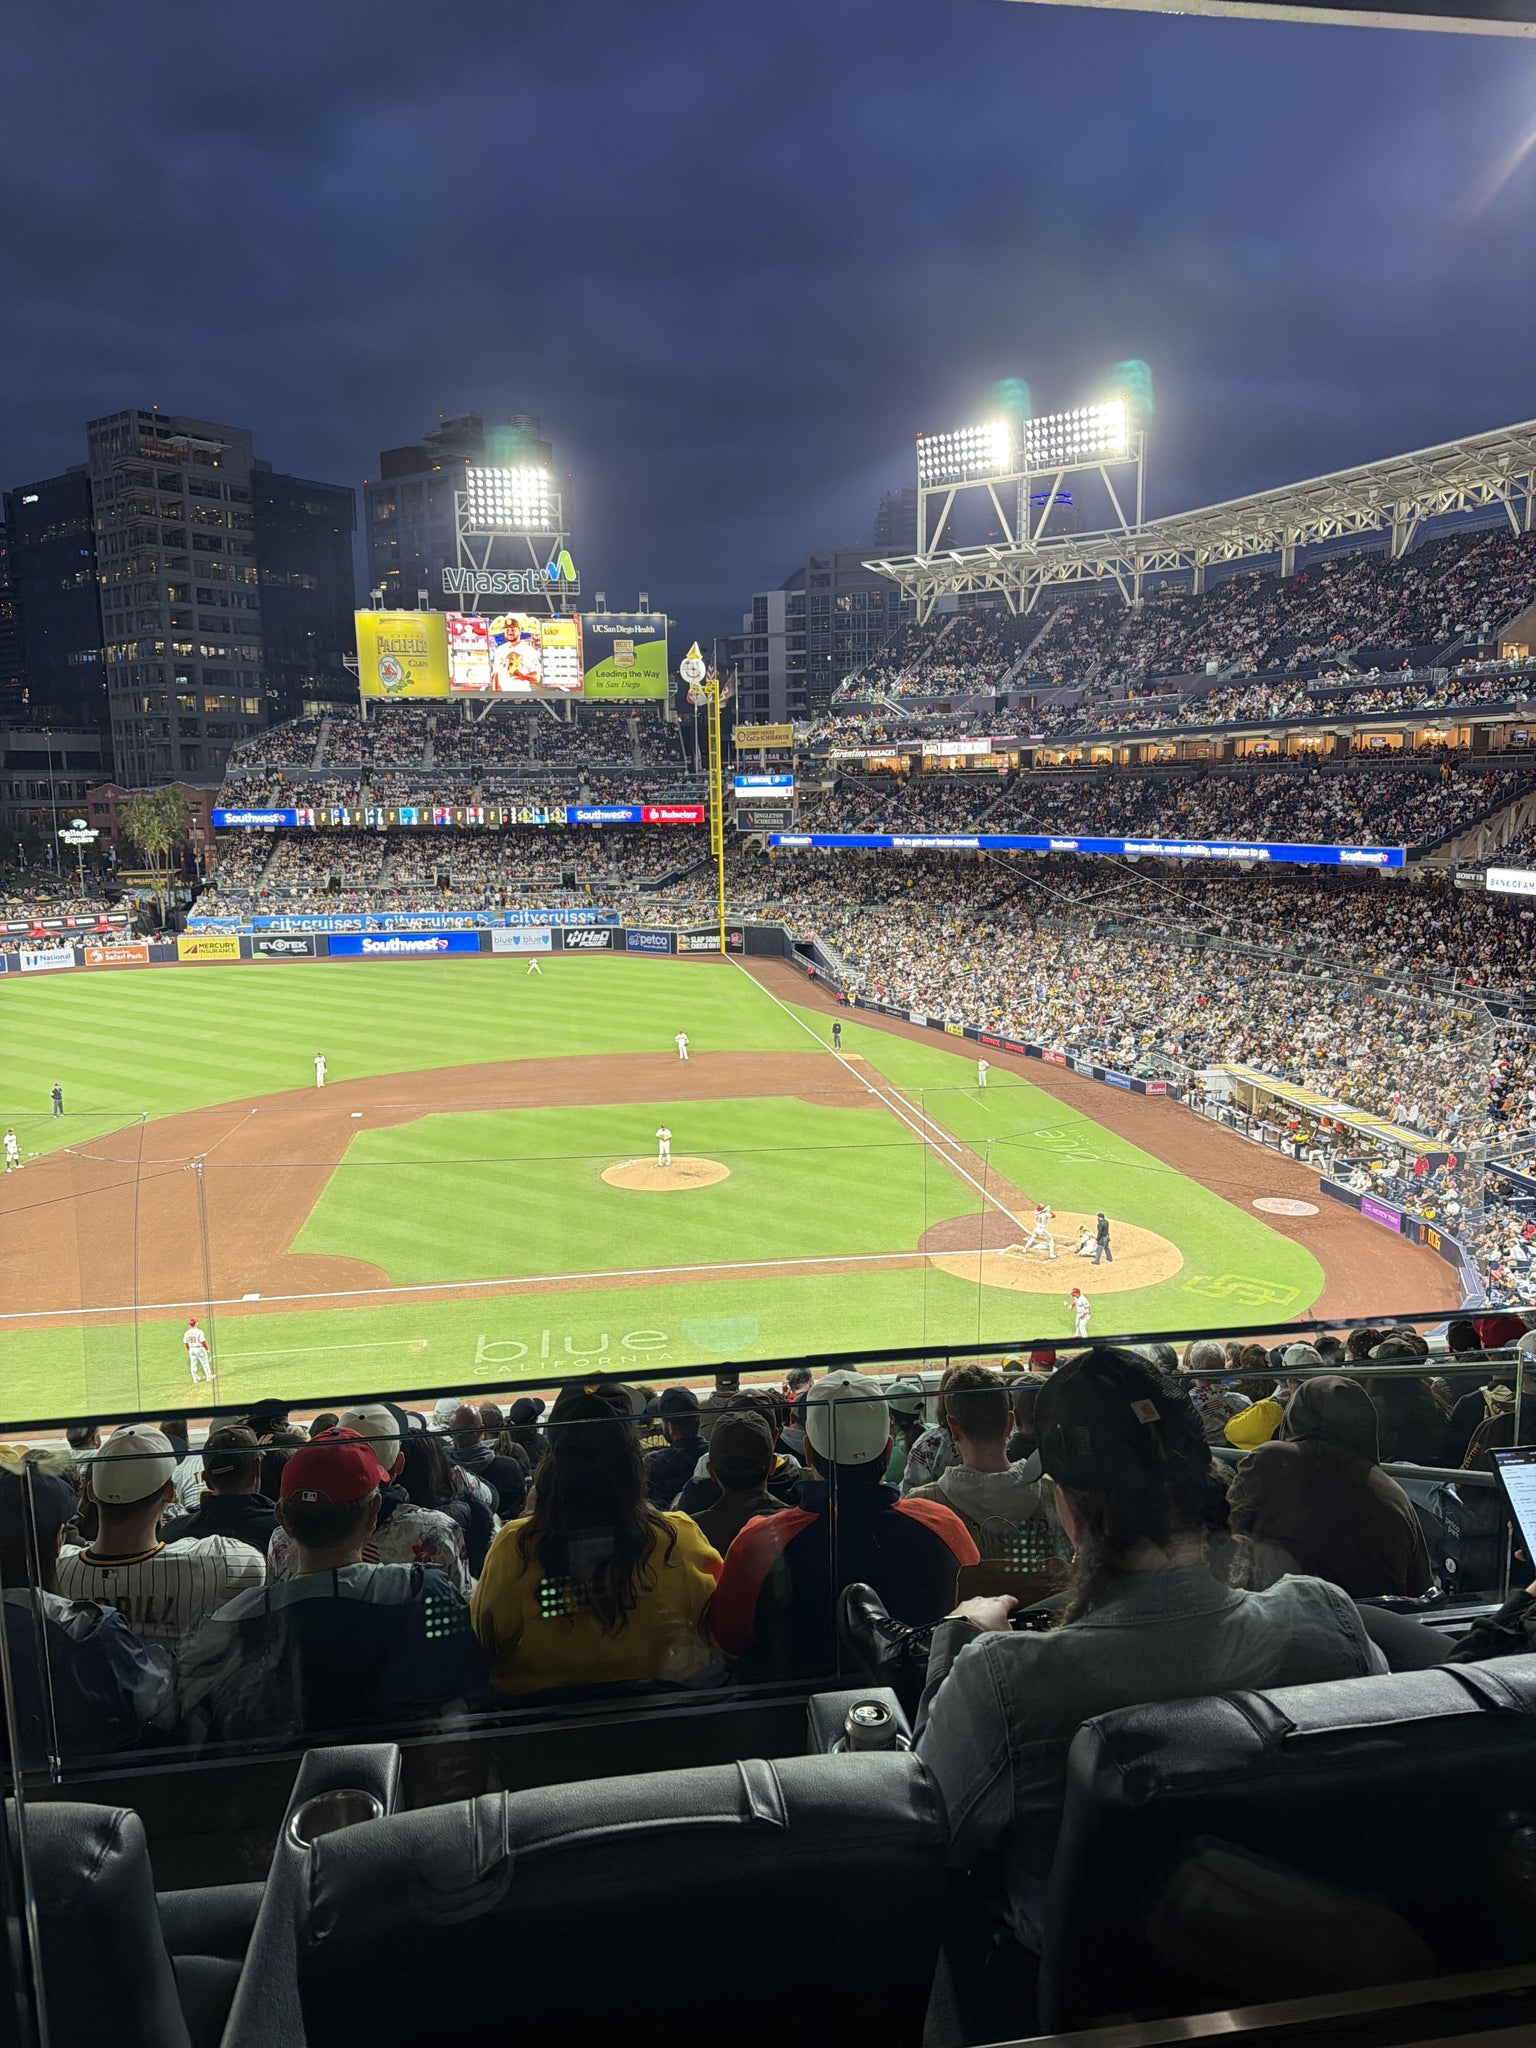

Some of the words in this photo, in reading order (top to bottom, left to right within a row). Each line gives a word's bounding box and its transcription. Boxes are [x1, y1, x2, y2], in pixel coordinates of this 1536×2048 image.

[446, 567, 539, 593] Viasat
[592, 624, 604, 633] UC
[604, 624, 616, 633] San
[616, 624, 634, 634] Diego
[634, 624, 655, 633] Health
[376, 636, 428, 654] PACIFICO
[596, 670, 628, 679] Leading
[629, 670, 642, 678] the
[643, 670, 660, 679] Way
[621, 681, 641, 689] Diego
[830, 748, 866, 758] Tarantino
[867, 749, 896, 757] SAUSAGES
[224, 813, 279, 823] Southwest
[577, 810, 626, 820] Southwest
[661, 810, 697, 819] Budweiser
[58, 829, 99, 838] Gallagher
[64, 836, 95, 845] Square
[1340, 850, 1384, 861] Southwest
[1490, 878, 1510, 888] BANK
[1512, 880, 1521, 888] OF
[511, 910, 596, 925] citycruises
[270, 917, 362, 930] citycruises
[494, 935, 513, 944] blue
[523, 935, 542, 943] blue
[582, 931, 611, 942] H2O
[640, 935, 668, 946] petco
[259, 939, 308, 951] EVOTEK
[362, 938, 438, 952] Southwest
[40, 952, 71, 961] National
[127, 952, 143, 960] Park
[475, 1329, 669, 1364] blue
[473, 1352, 673, 1375] CALIFORNIA
